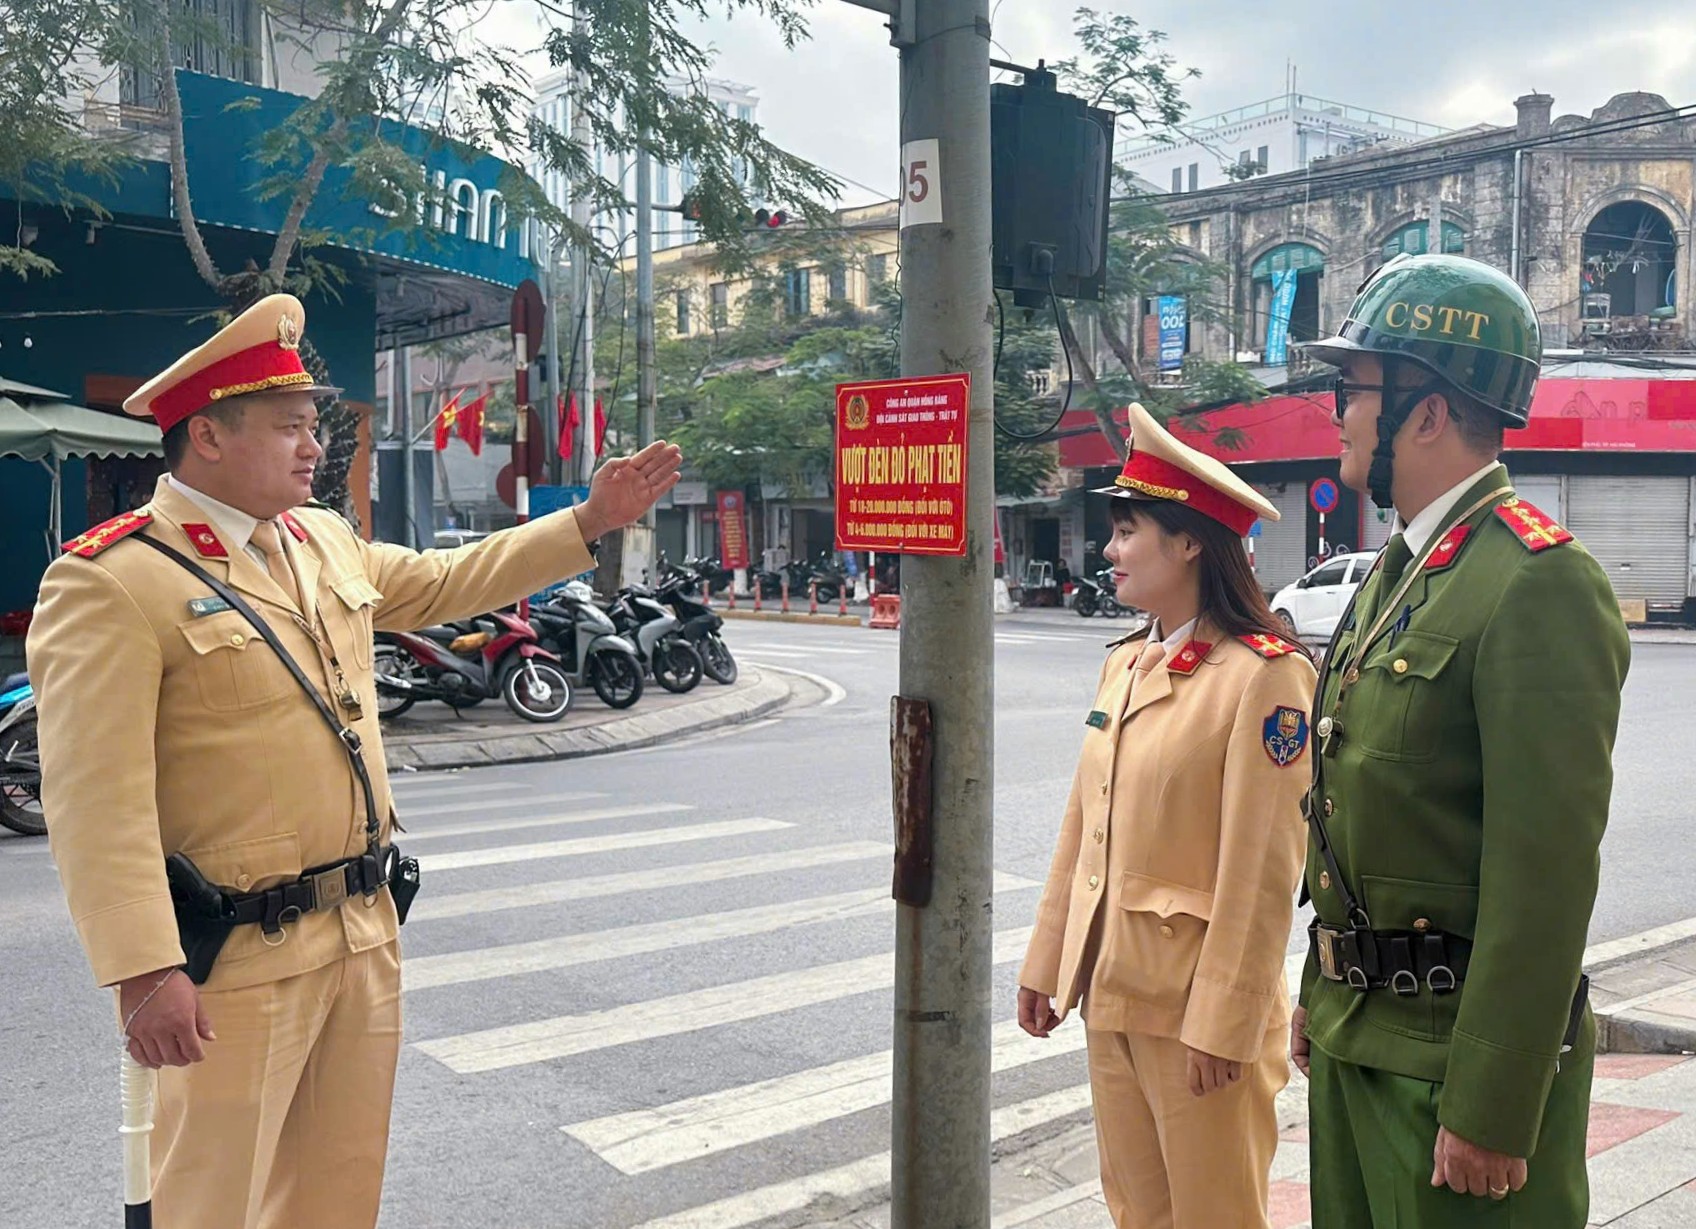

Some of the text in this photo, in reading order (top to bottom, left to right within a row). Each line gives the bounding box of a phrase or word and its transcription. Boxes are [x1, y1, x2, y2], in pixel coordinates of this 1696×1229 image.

[1385, 301, 1490, 340] CSTT
[886, 397, 899, 408] CÔNG
[899, 398, 907, 408] AN
[907, 396, 920, 408] QUẬN
[876, 413, 885, 426] ĐỘI
[885, 412, 897, 424] CẢNH
[898, 411, 907, 423] SÁT
[908, 412, 919, 423] GIAO
[919, 410, 935, 421] THÔNG
[939, 410, 950, 422] TRẬT
[951, 409, 958, 422] TỰ
[842, 430, 961, 494] VƯỢT ĐÈN ĐỎ PHẠT TIỀN
[849, 497, 858, 514] TỪ
[897, 495, 914, 515] ĐỒNG
[928, 498, 938, 515] VỚI
[846, 520, 855, 537] TỪ
[888, 519, 904, 538] ĐỒNG
[918, 521, 928, 538] VỚI
[929, 524, 938, 539] XE
[1269, 735, 1299, 748] CS GT
